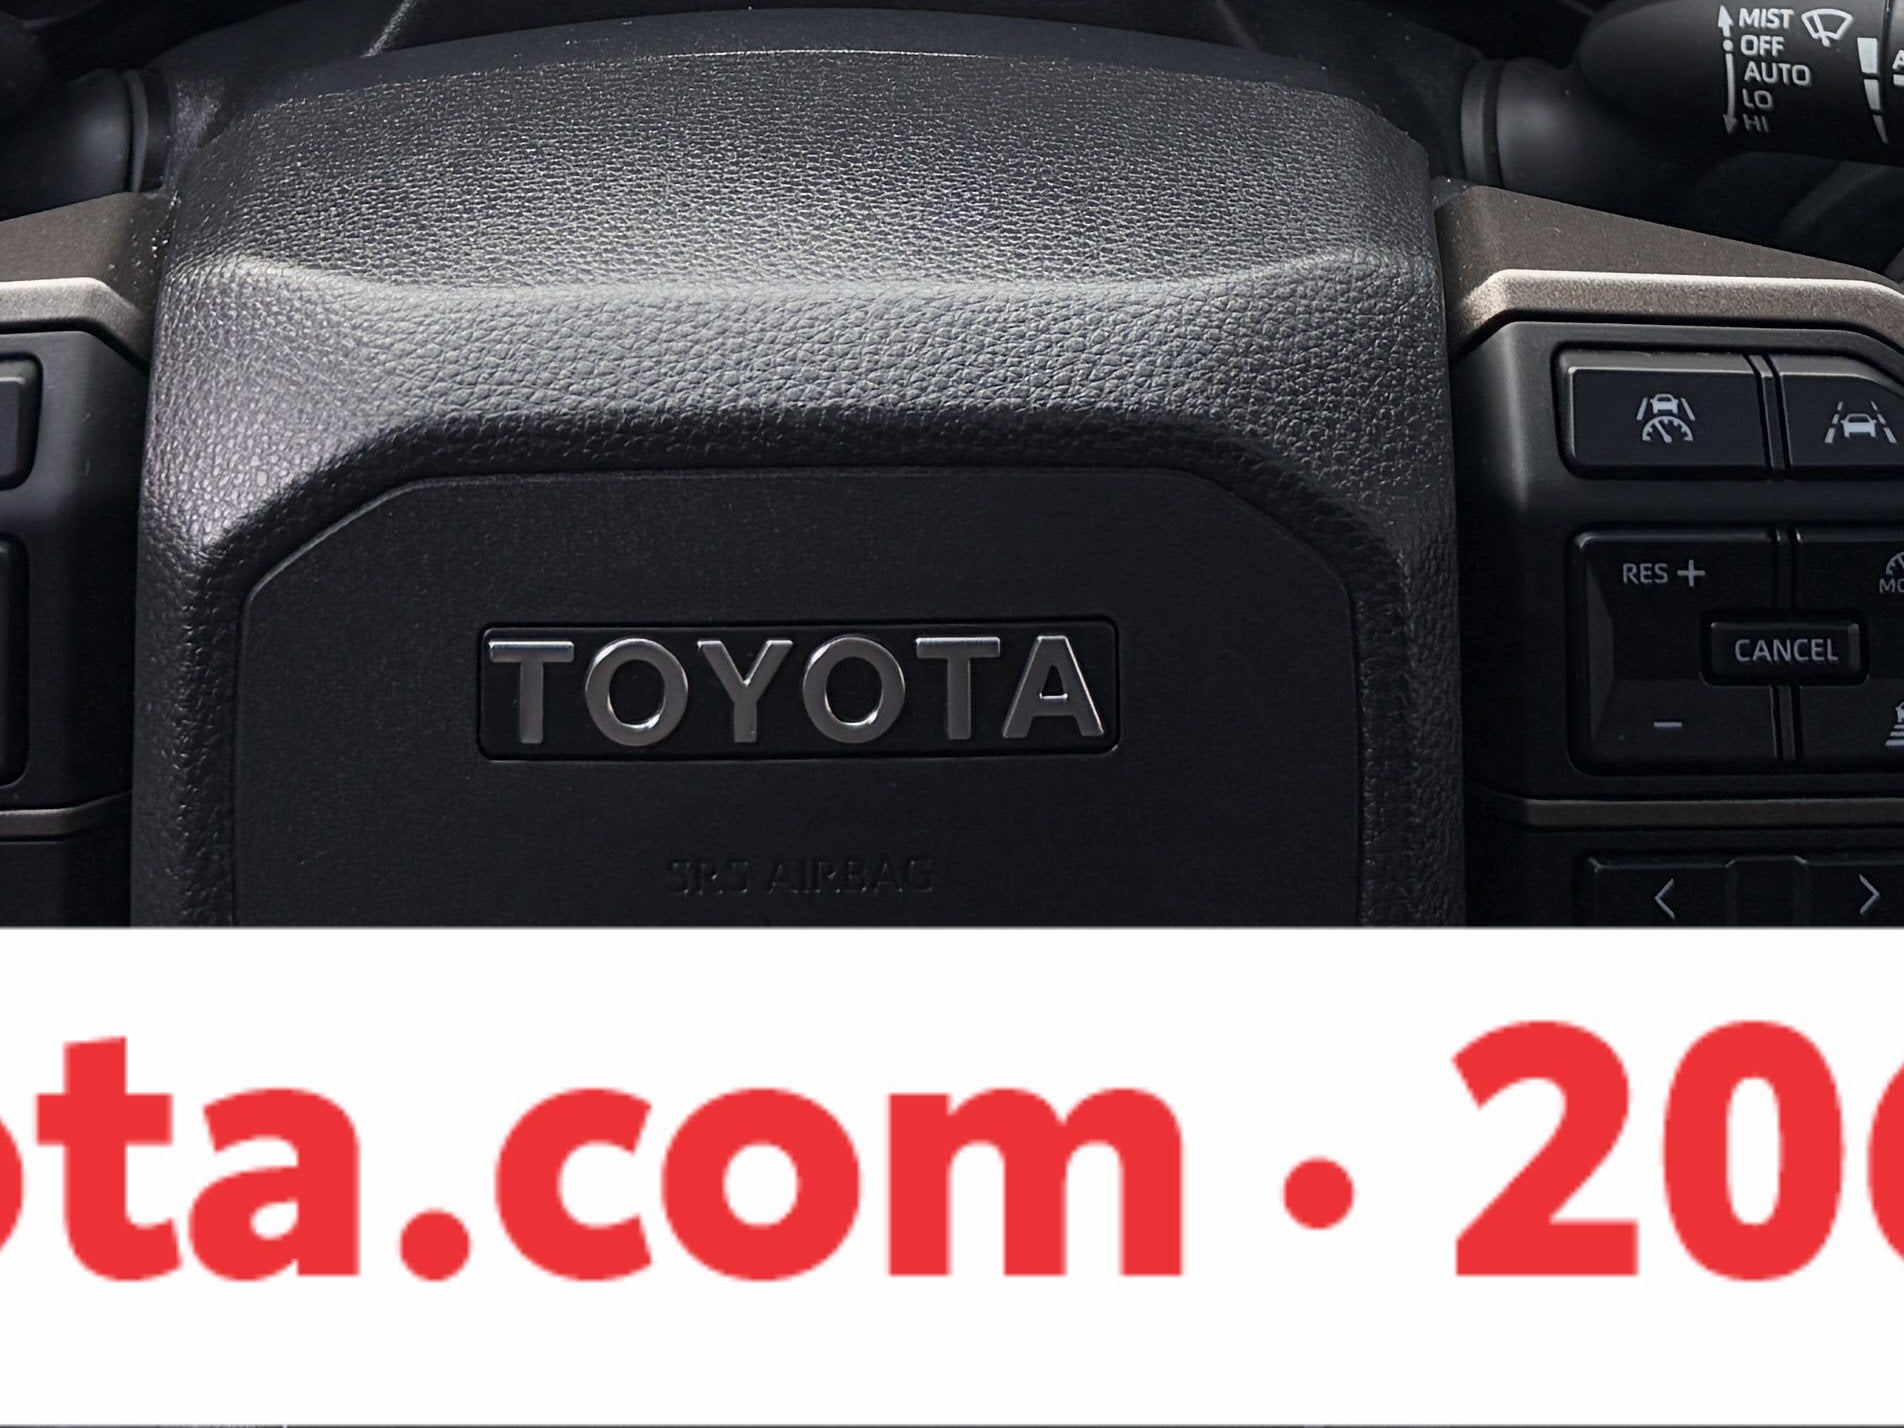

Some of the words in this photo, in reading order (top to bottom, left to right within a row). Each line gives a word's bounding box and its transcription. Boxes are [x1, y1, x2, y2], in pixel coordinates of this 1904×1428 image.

[1739, 8, 1794, 29] MIST
[1741, 35, 1784, 57] OFF
[1744, 62, 1811, 85] AUTO
[1743, 89, 1772, 110] LO
[1744, 114, 1769, 134] HI
[1623, 563, 1668, 584] RES
[1735, 639, 1838, 662] CANCEL
[489, 635, 1105, 747] TOYOTA
[768, 855, 933, 894] AIRBAG
